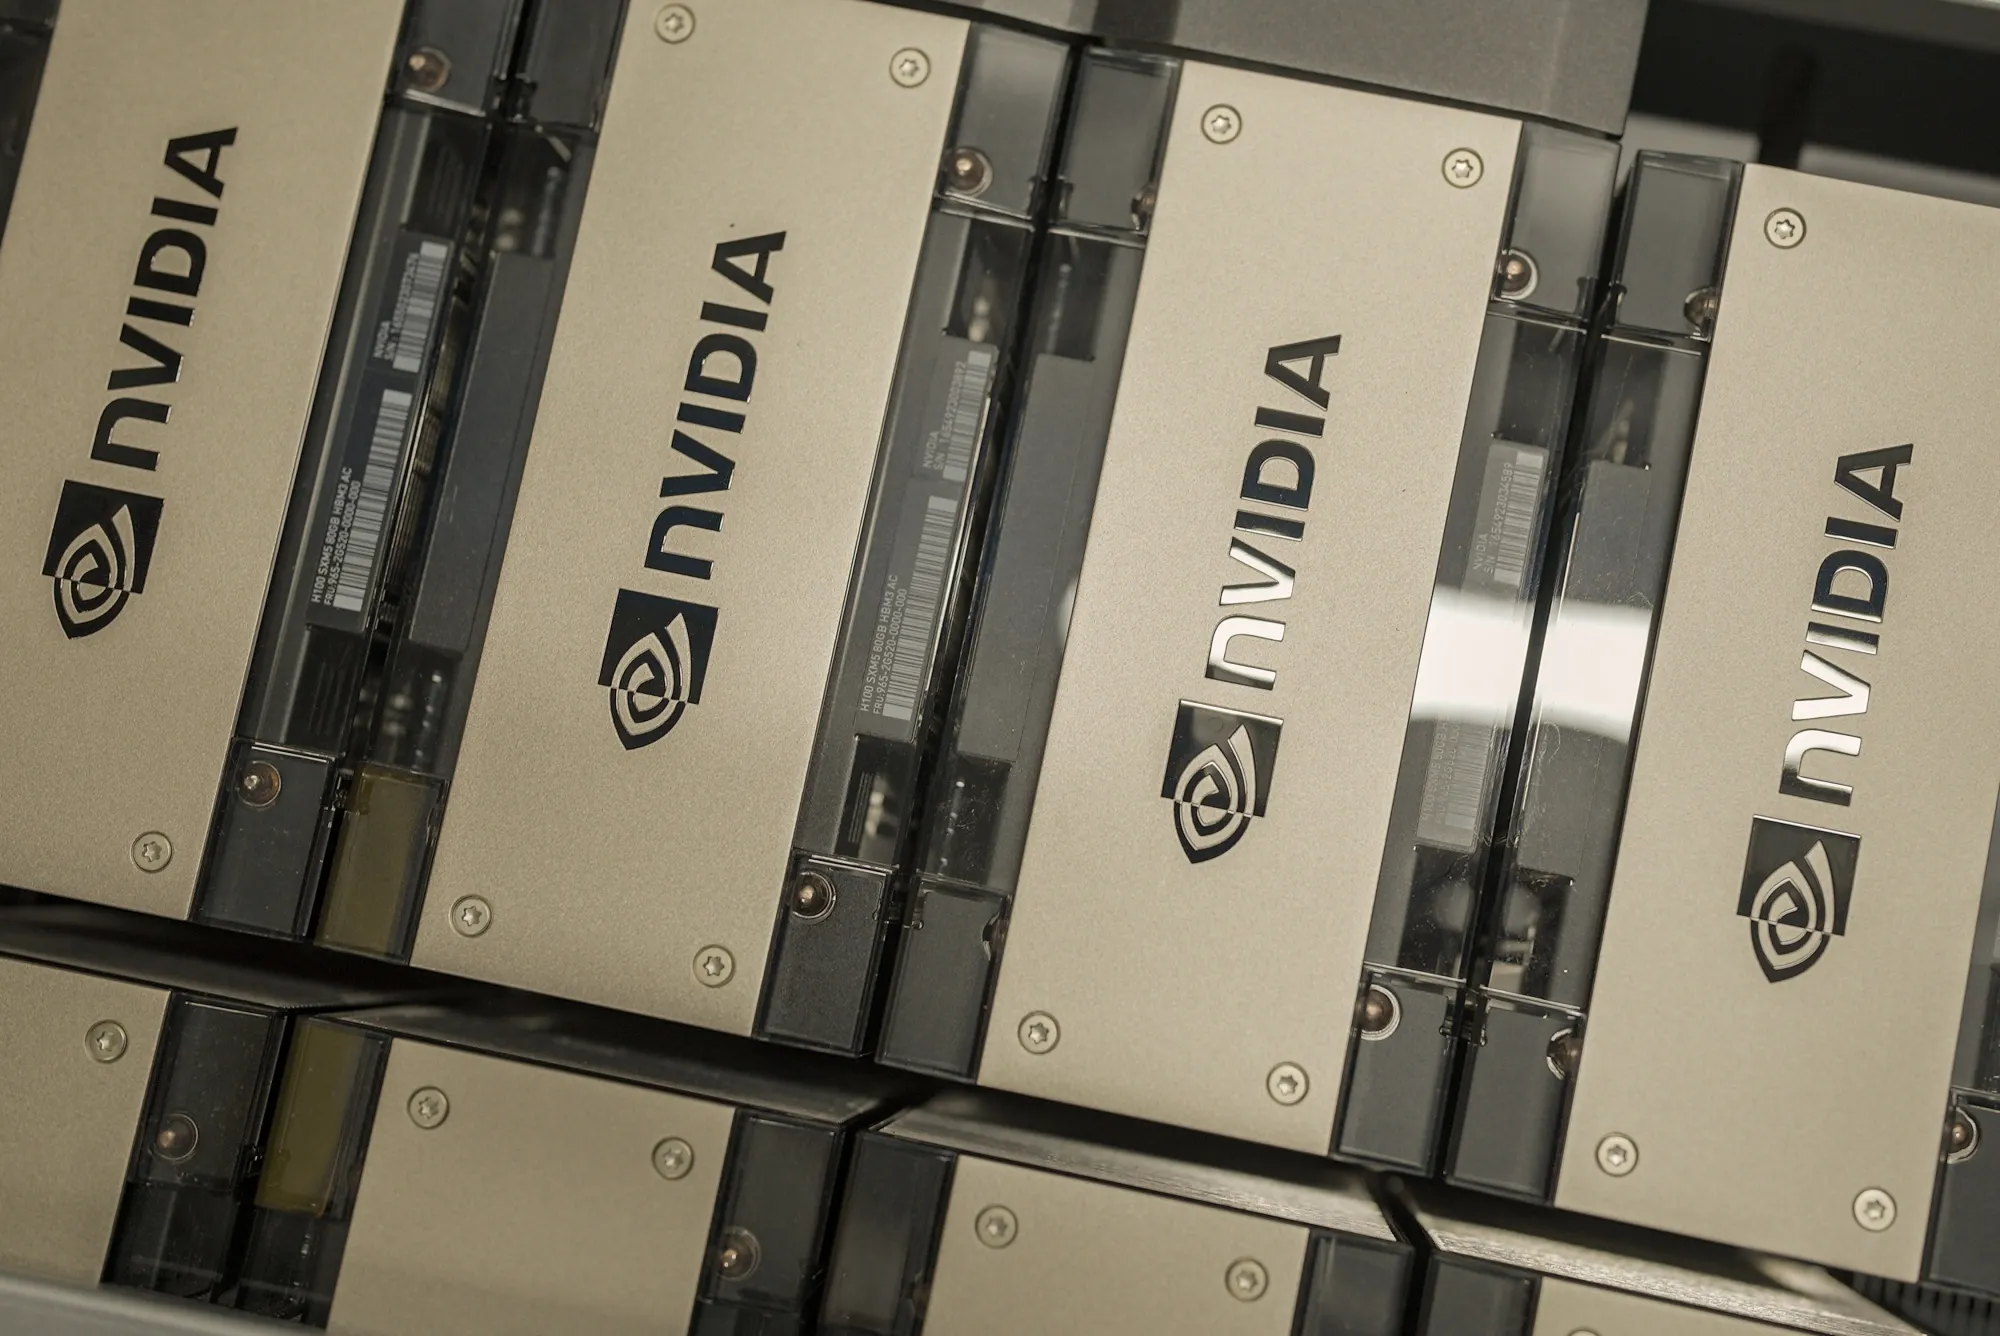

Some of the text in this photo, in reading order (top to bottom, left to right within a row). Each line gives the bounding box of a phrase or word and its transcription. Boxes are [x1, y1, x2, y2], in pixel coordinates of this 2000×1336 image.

[922, 430, 939, 468] NVIDIA
[311, 467, 352, 603] H100 SXM5 80GB HBM3 AC
[1472, 532, 1488, 570] NVIDIA
[1490, 462, 1513, 545] 1654923034589
[861, 574, 898, 712] H100 SXM5 80GB HBM3 AC
[874, 588, 907, 714] FRU:965-2G520-0000-000
